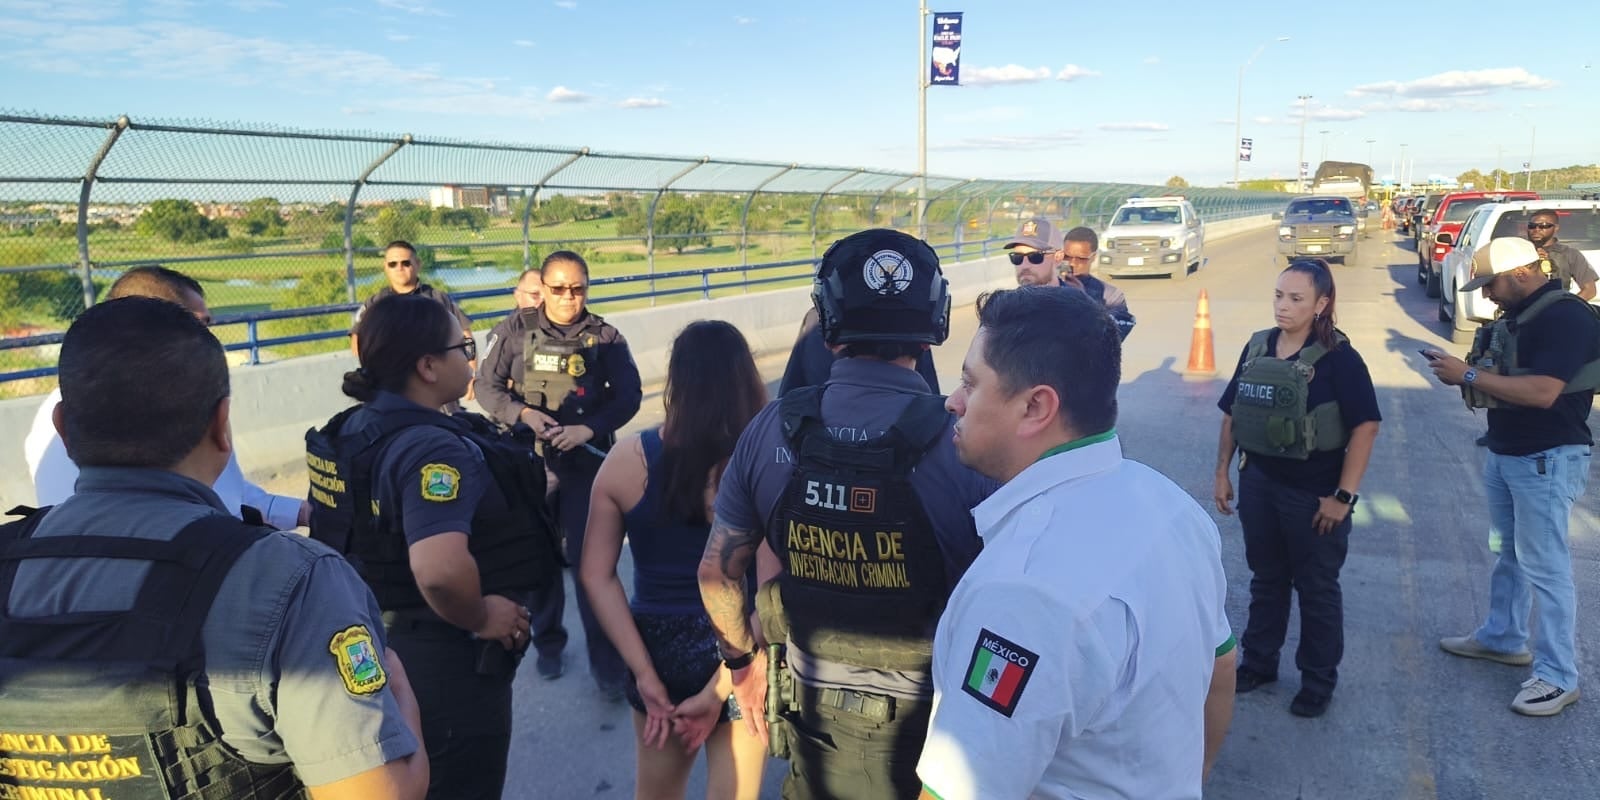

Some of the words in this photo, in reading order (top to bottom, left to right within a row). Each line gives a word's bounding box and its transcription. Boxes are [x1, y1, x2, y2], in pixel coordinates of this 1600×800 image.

[1238, 382, 1274, 400] POLICE
[825, 426, 869, 442] NCIA
[805, 480, 847, 511] 5.11
[787, 519, 868, 561] AGENCIA
[875, 531, 905, 560] DE
[788, 551, 859, 588] INVESTIGACION
[860, 562, 911, 588] CRIMINAL
[982, 637, 1029, 667] MÉXICO
[0, 733, 67, 753] NCIA
[67, 734, 112, 754] DE
